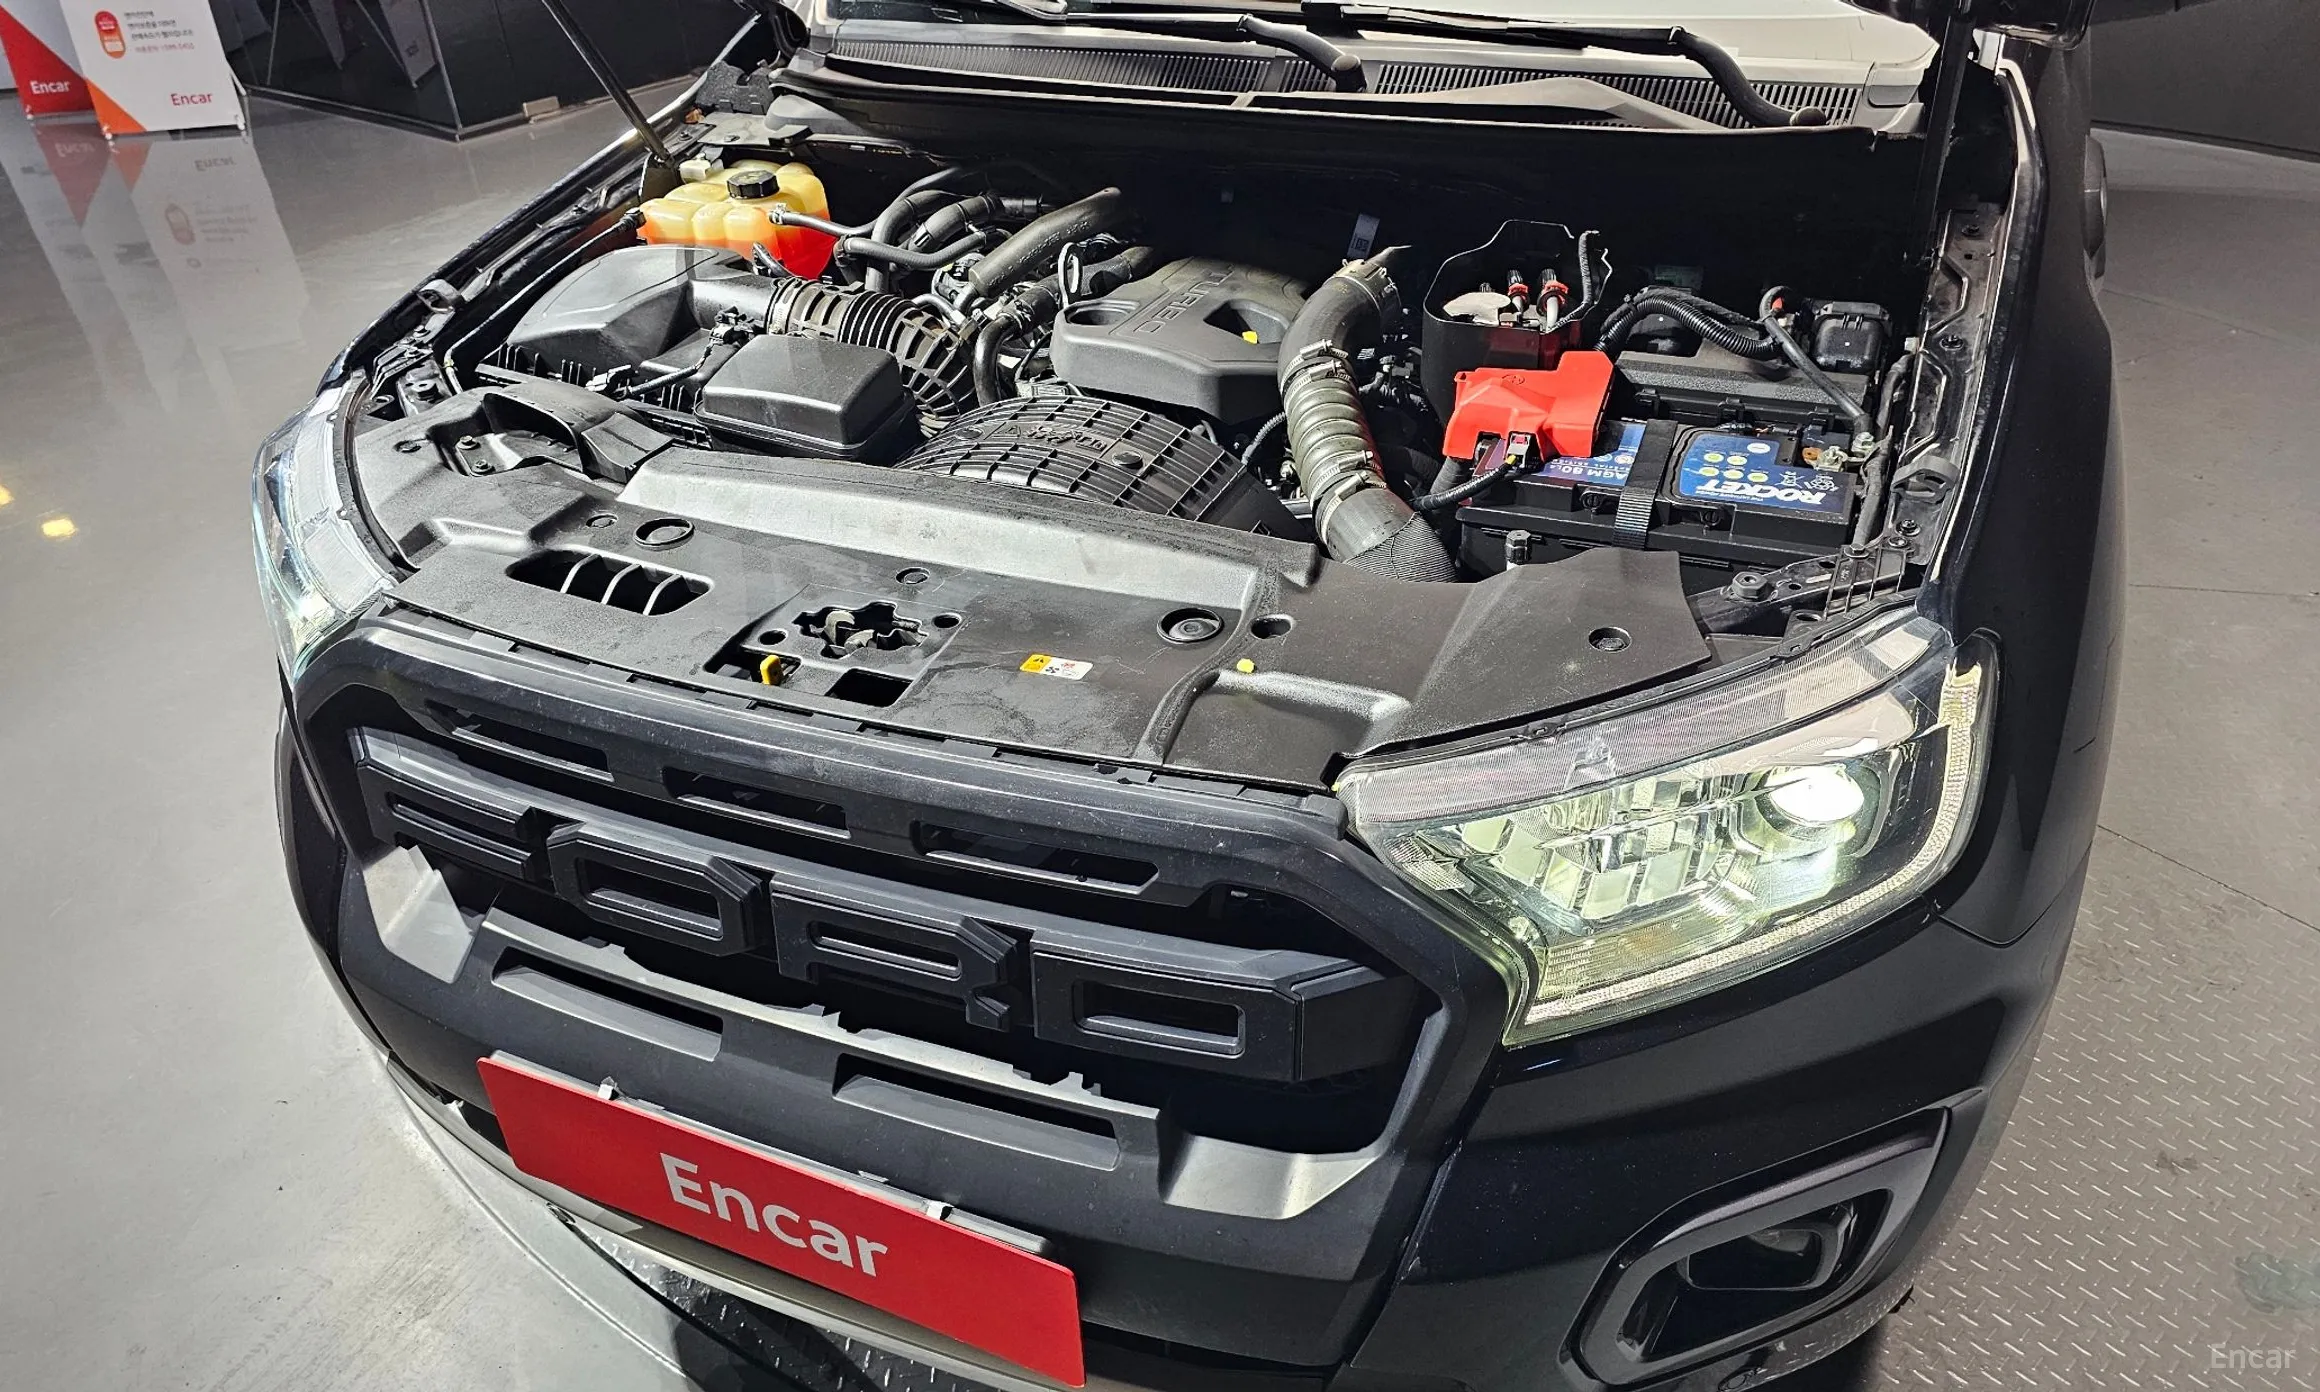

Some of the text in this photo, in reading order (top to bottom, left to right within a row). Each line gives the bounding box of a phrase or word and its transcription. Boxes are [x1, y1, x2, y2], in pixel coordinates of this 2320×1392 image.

[30, 80, 70, 94] Encar
[171, 93, 212, 106] Encar
[1587, 468, 1629, 480] AGM
[1696, 479, 1826, 505] ROCKET
[356, 728, 1340, 1082] FORD
[660, 1152, 888, 1277] Encar
